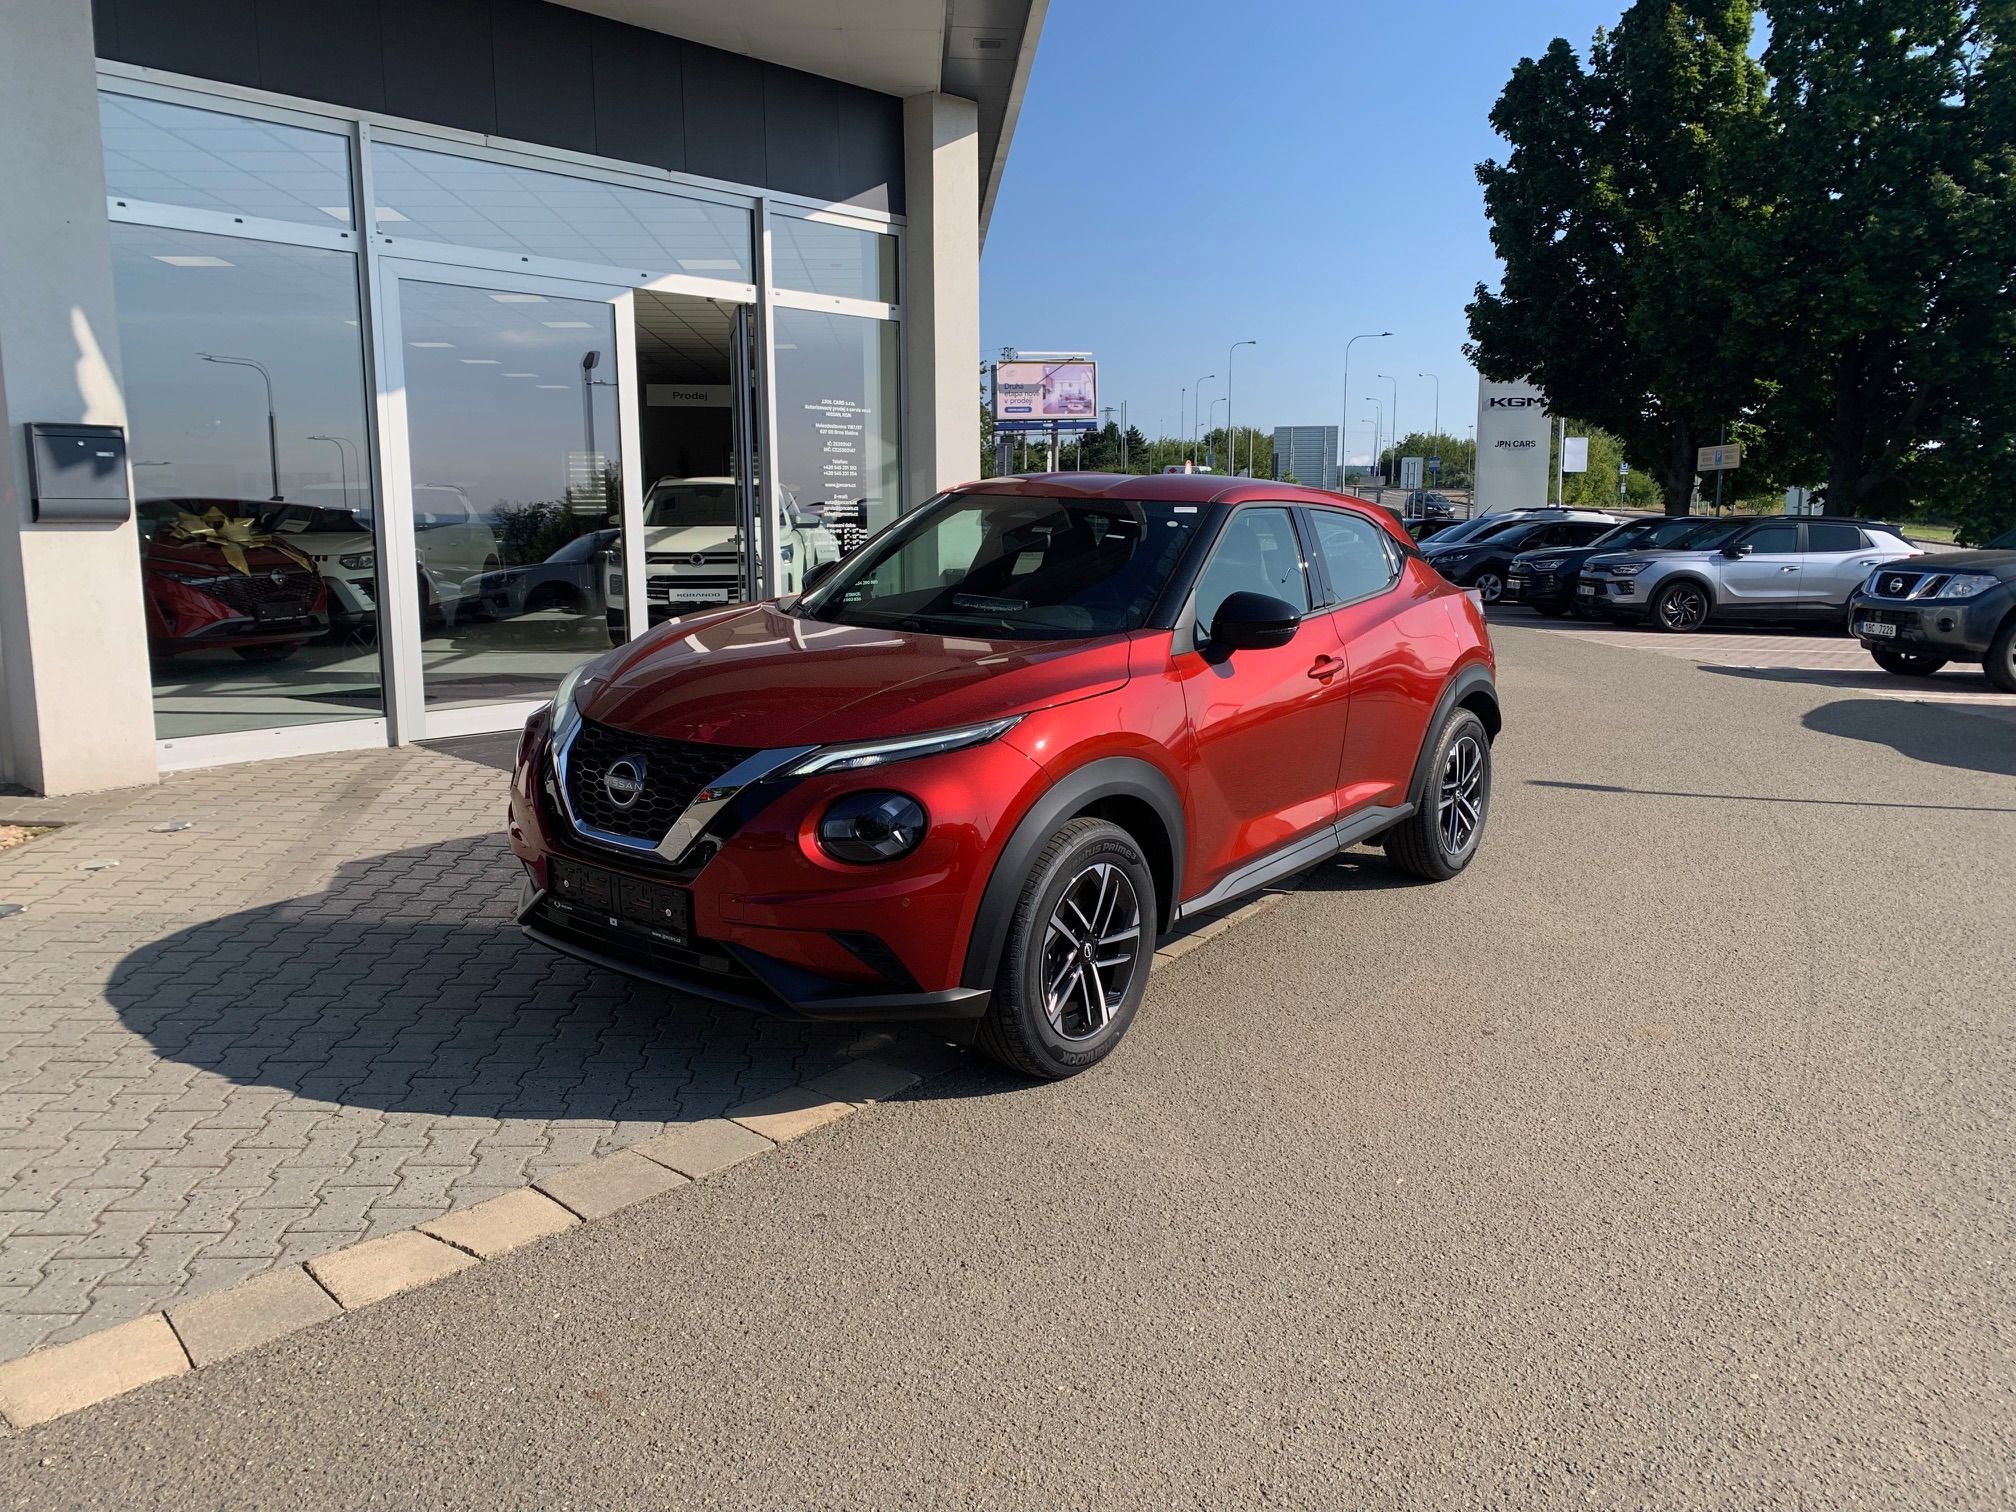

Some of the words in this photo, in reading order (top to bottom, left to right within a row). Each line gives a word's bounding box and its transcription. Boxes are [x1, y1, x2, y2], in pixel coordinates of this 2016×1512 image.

[672, 391, 708, 402] Prodej
[1490, 397, 1547, 408] KGM
[1494, 440, 1511, 449] JPN
[1512, 440, 1537, 449] CARS
[604, 775, 643, 791] ISSAN
